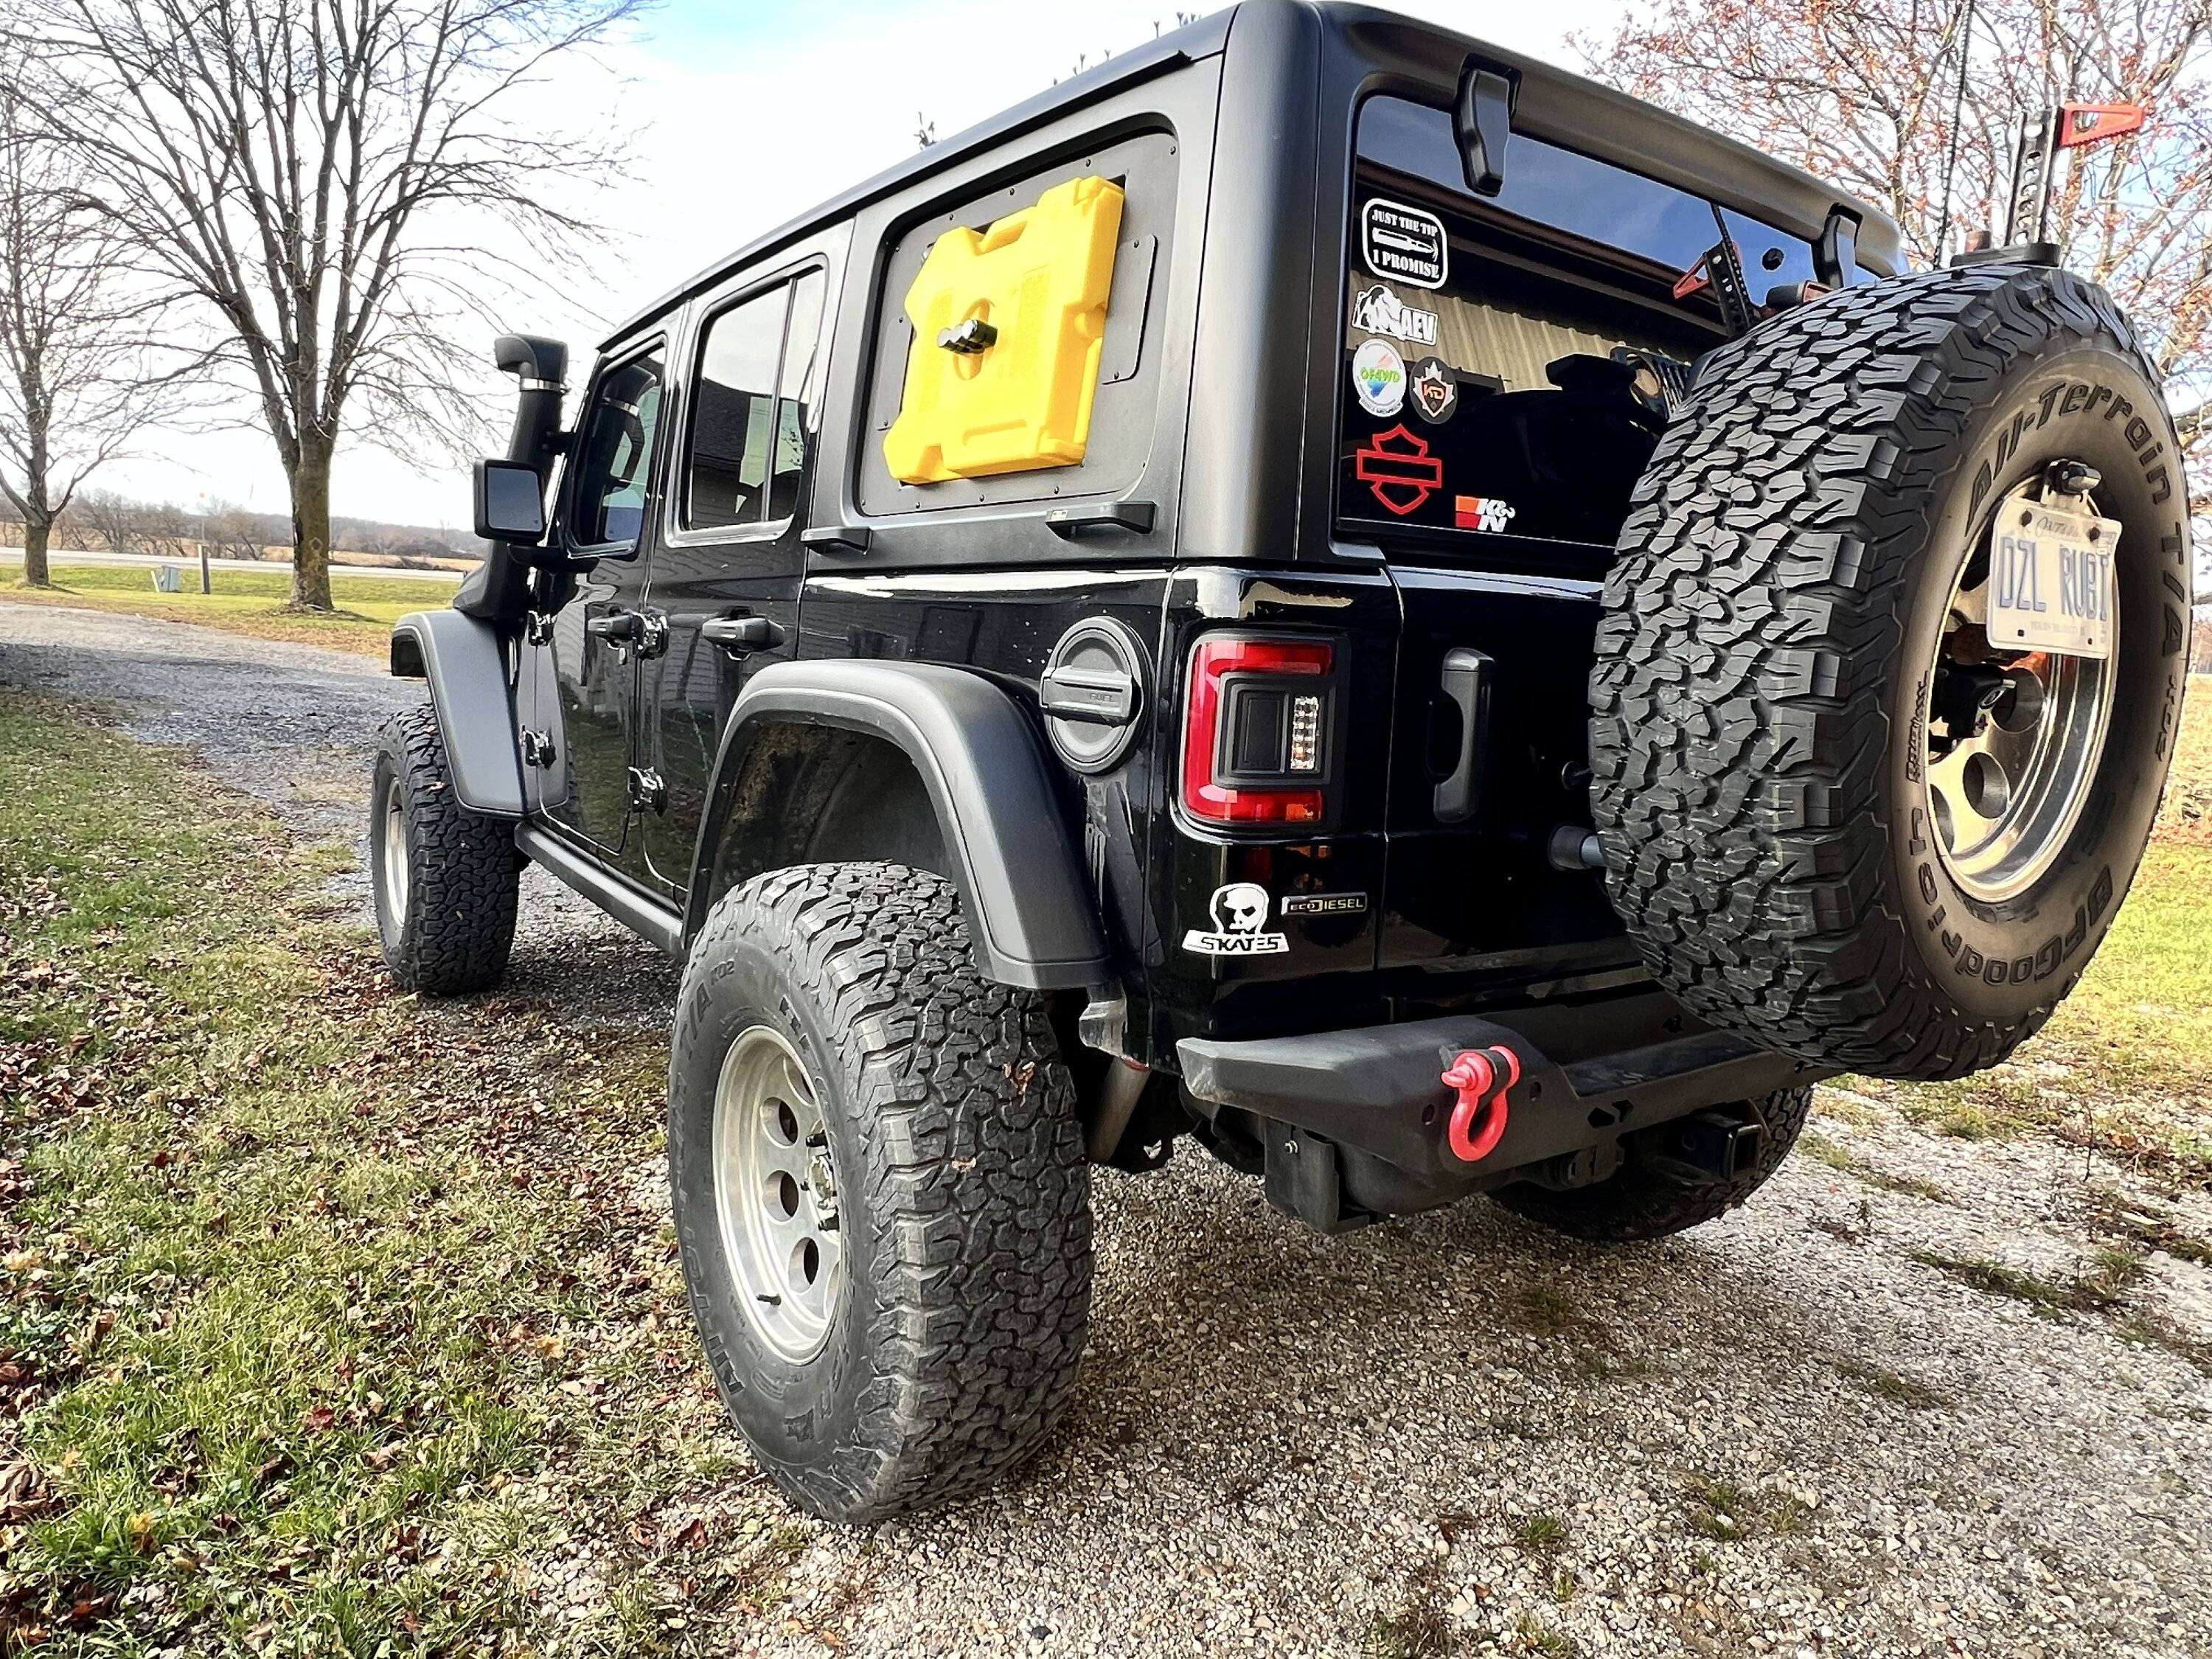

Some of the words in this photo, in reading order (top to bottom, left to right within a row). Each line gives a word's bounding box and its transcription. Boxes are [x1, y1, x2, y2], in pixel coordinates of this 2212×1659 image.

[1371, 209, 1399, 226] JUST
[1399, 215, 1420, 232] THE
[1419, 222, 1438, 237] TIP
[1382, 251, 1440, 279] PROMISE
[1399, 307, 1435, 343] AEV
[1964, 380, 2172, 538] All-Terrain
[2160, 521, 2185, 657] T/A
[1999, 536, 2047, 613] DZL
[2059, 542, 2110, 622] RUBI
[1089, 692, 1113, 703] FUEL
[1909, 807, 2114, 986] BFGoodrich
[1199, 936, 1282, 951] SKATES
